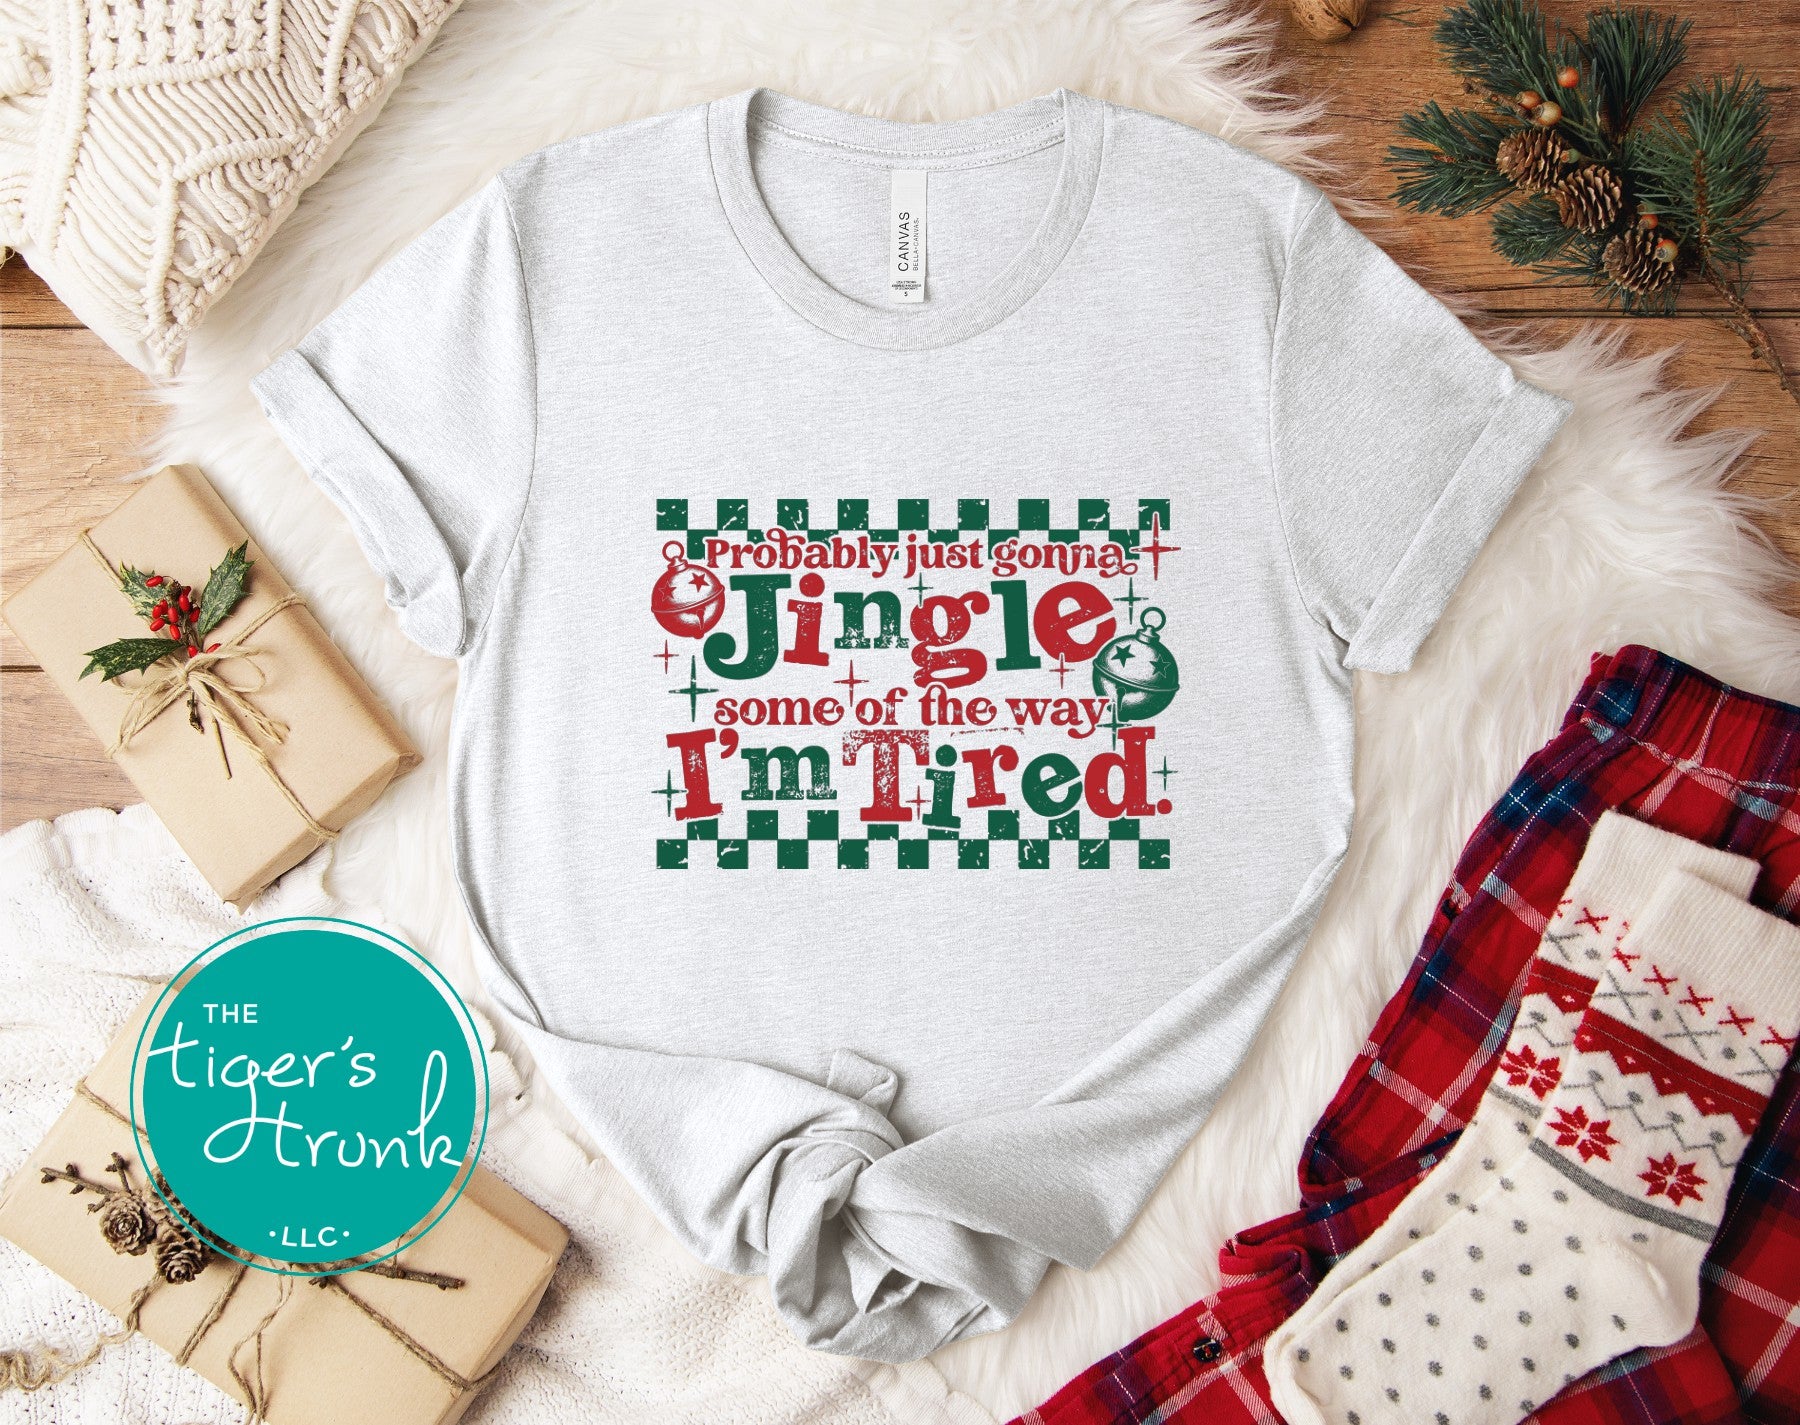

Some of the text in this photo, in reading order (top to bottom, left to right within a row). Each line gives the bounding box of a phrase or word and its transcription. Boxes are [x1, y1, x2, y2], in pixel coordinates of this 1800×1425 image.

[898, 212, 910, 272] CANVAS
[706, 528, 1138, 578] Probably just gonna
[702, 572, 1117, 689] Jingle
[713, 684, 1110, 739] some of the way
